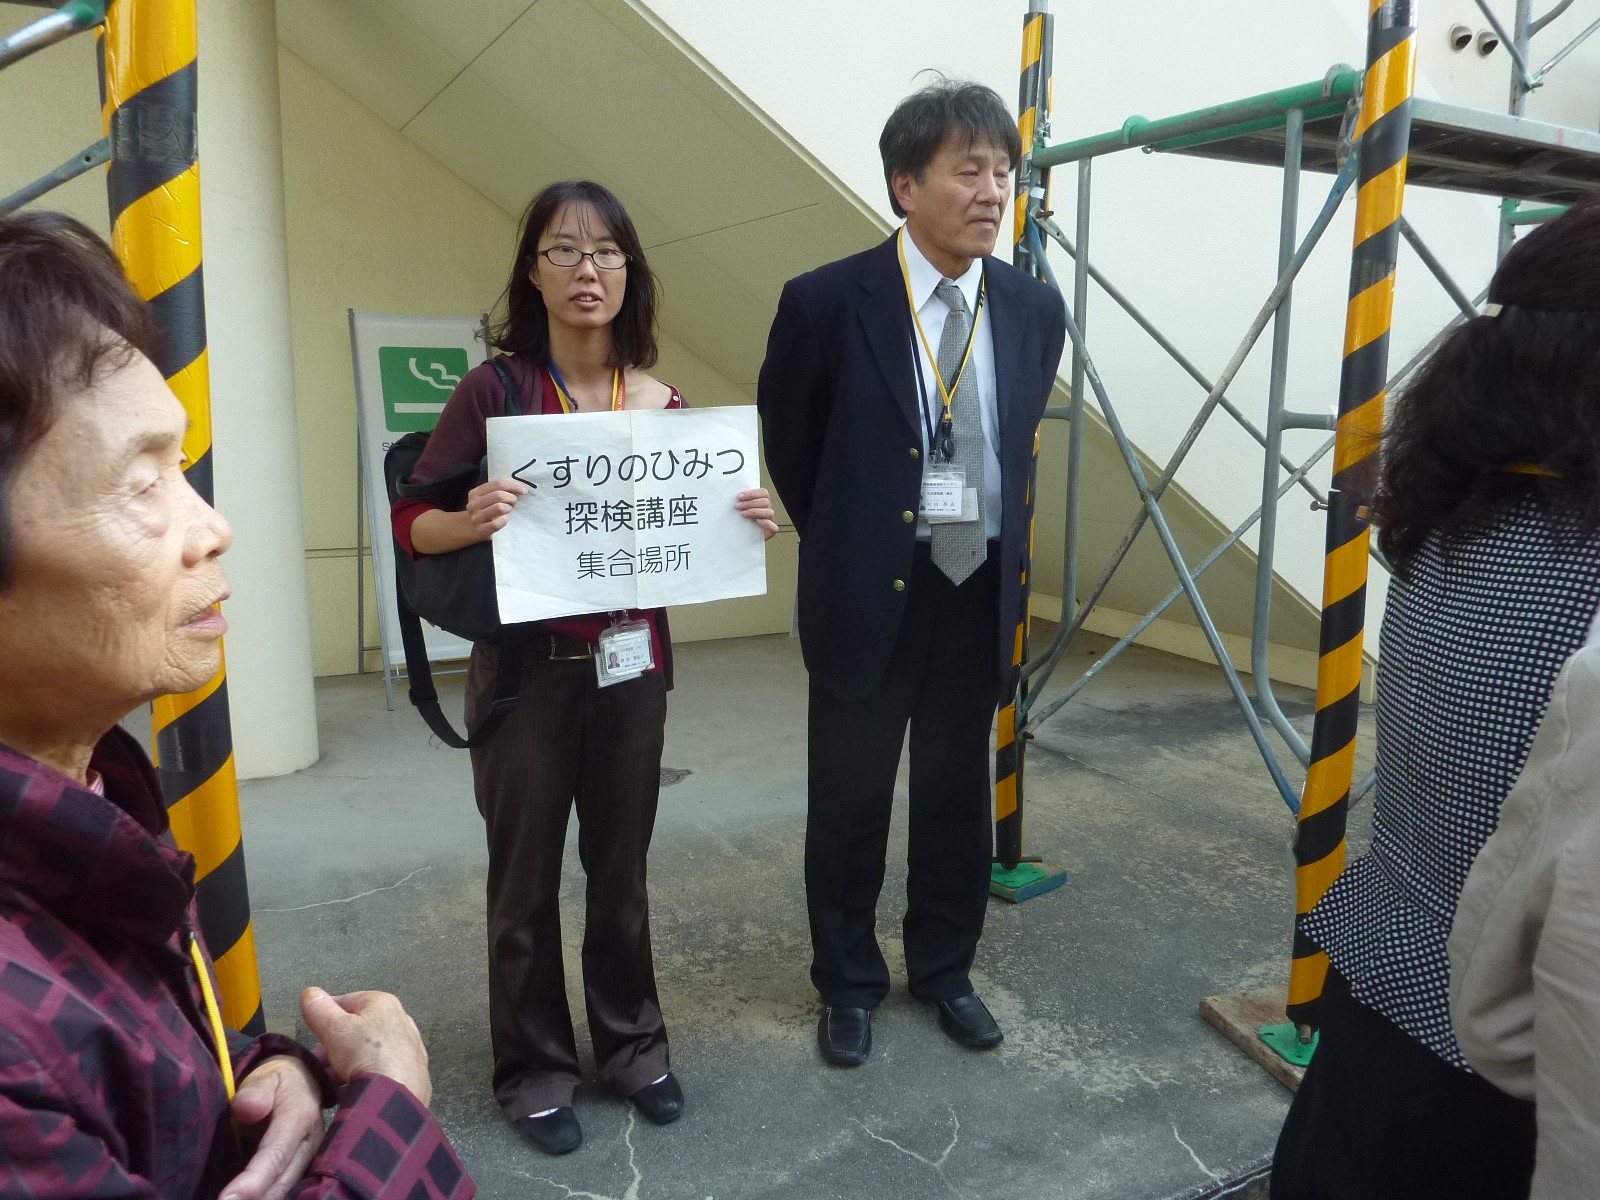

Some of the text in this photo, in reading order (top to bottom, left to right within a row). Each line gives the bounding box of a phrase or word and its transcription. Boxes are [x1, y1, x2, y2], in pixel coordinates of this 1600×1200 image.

[511, 448, 745, 489] くすりのひみつ
[565, 494, 699, 535] 探検講座
[576, 543, 692, 580] 集合場所
